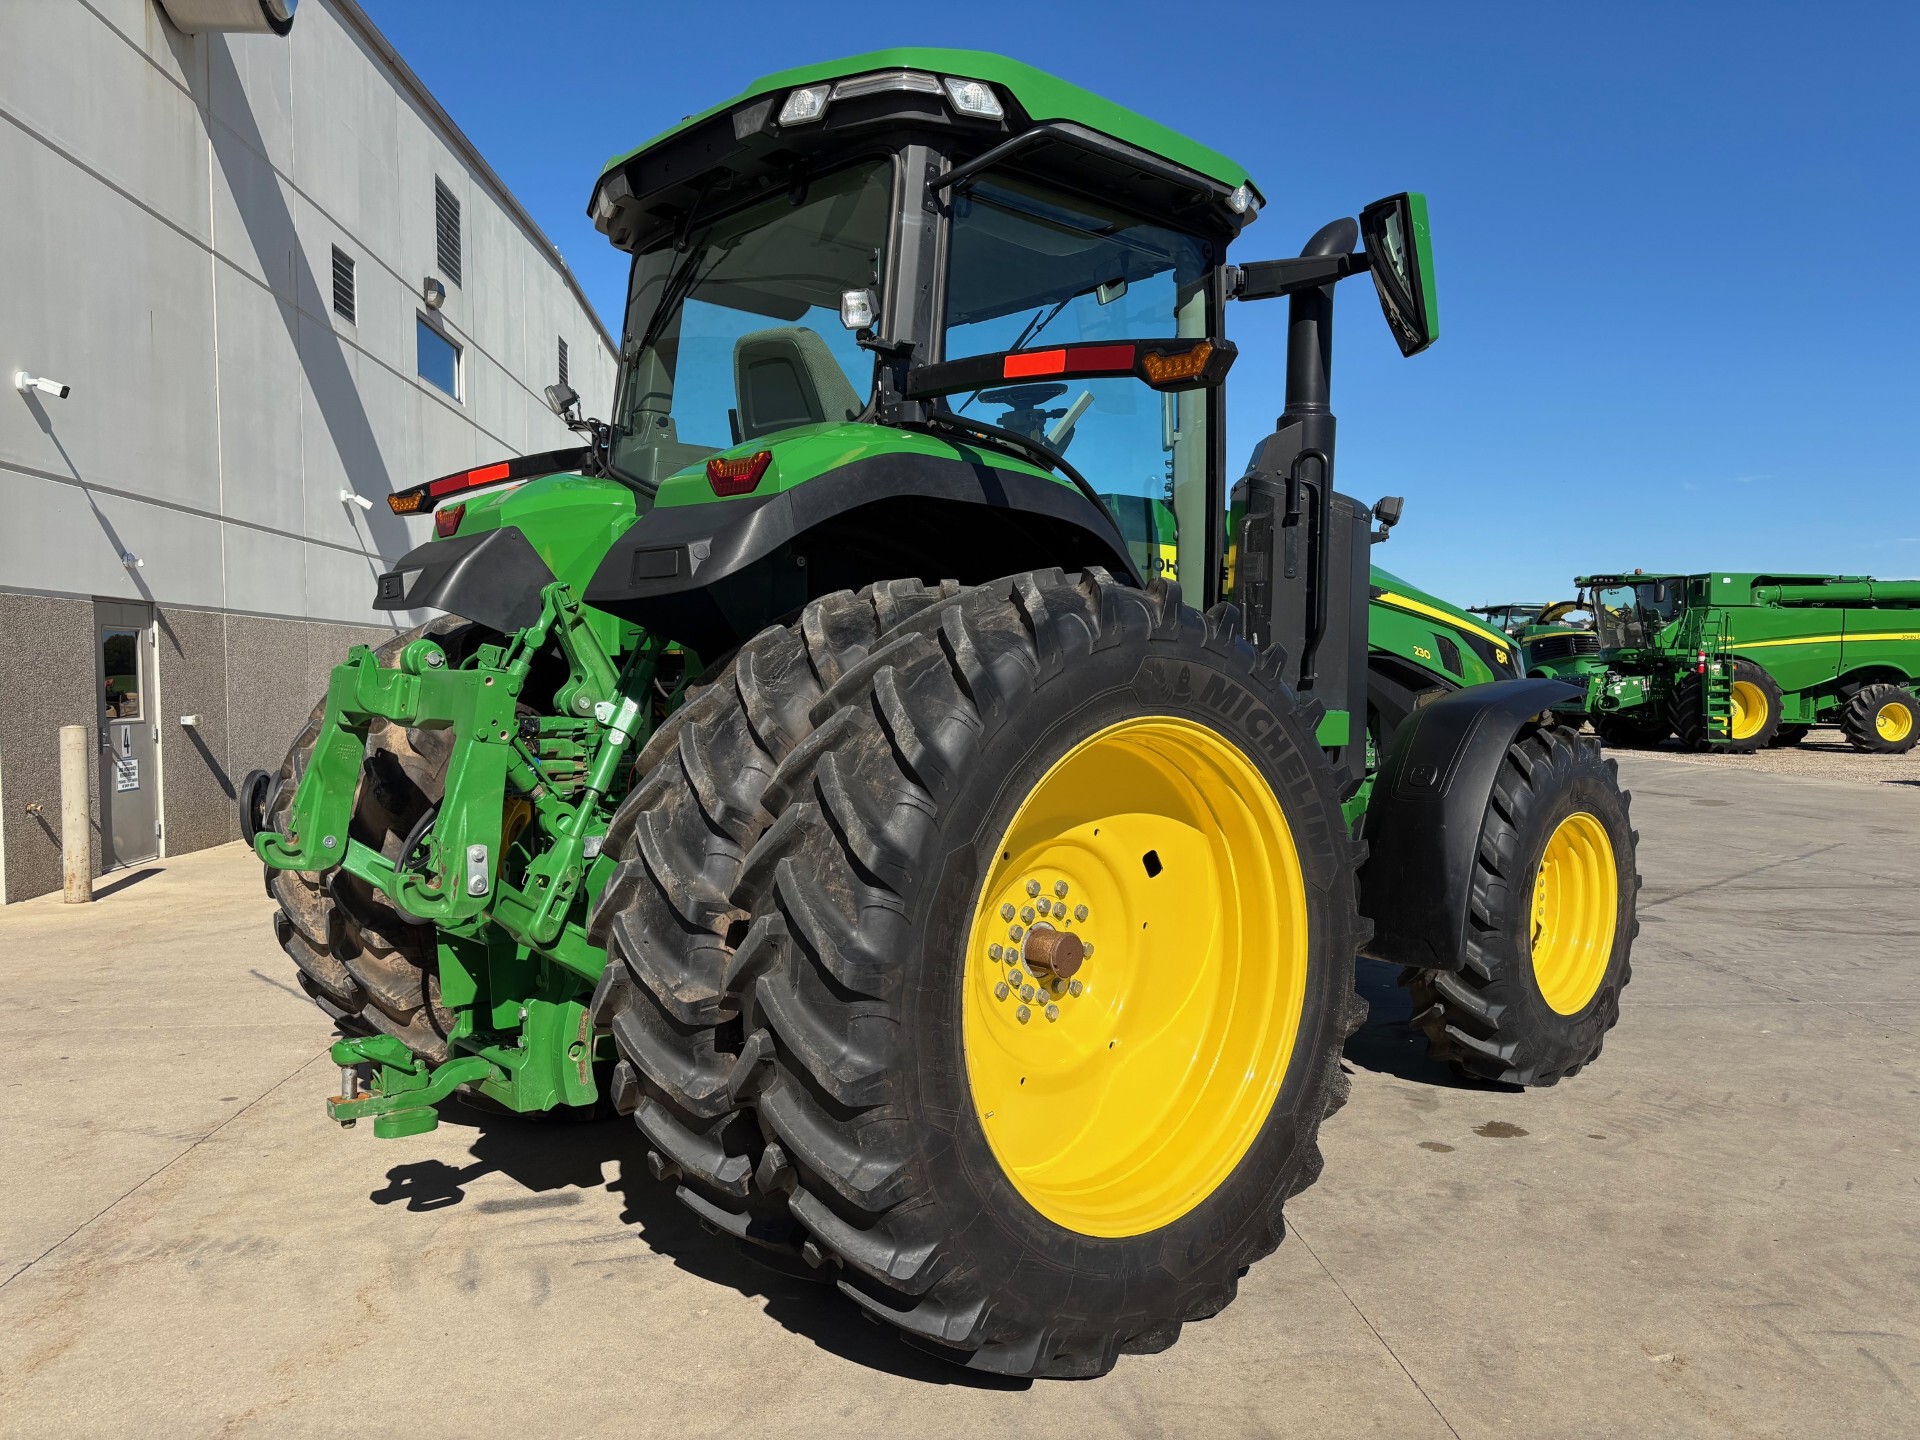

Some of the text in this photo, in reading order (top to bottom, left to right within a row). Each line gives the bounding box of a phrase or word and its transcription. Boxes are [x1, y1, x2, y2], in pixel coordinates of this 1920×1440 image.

[1413, 645, 1431, 660] 230
[1495, 648, 1508, 664] 8R
[124, 727, 130, 754] 4
[1201, 673, 1334, 856] MICHELIN
